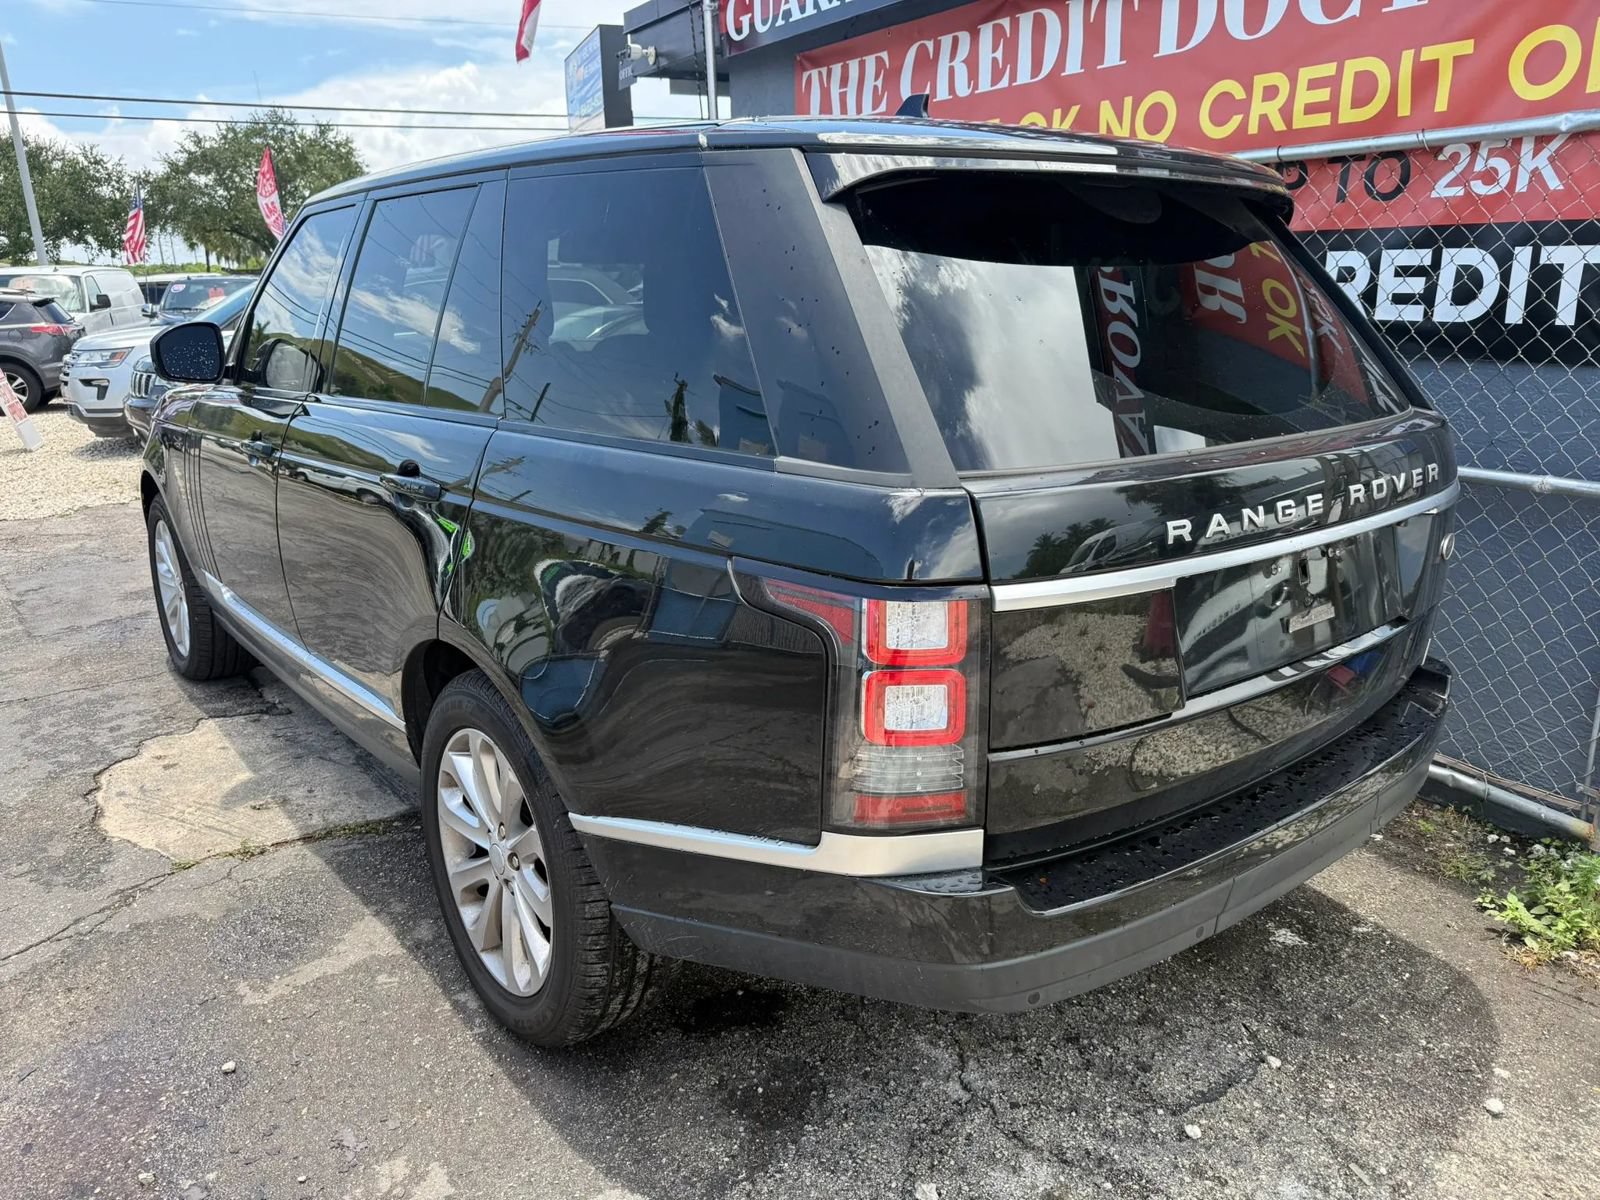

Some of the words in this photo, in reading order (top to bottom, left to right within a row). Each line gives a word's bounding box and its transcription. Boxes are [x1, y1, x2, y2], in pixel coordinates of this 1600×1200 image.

[802, 51, 889, 117] THE
[900, 0, 1139, 103] CREDIT
[1099, 90, 1178, 144] NO
[1199, 39, 1475, 139] CREDIT
[1327, 150, 1411, 203] TO
[1431, 133, 1571, 198] 25K
[1165, 493, 1325, 545] RANGE
[1348, 463, 1440, 506] ROVER
